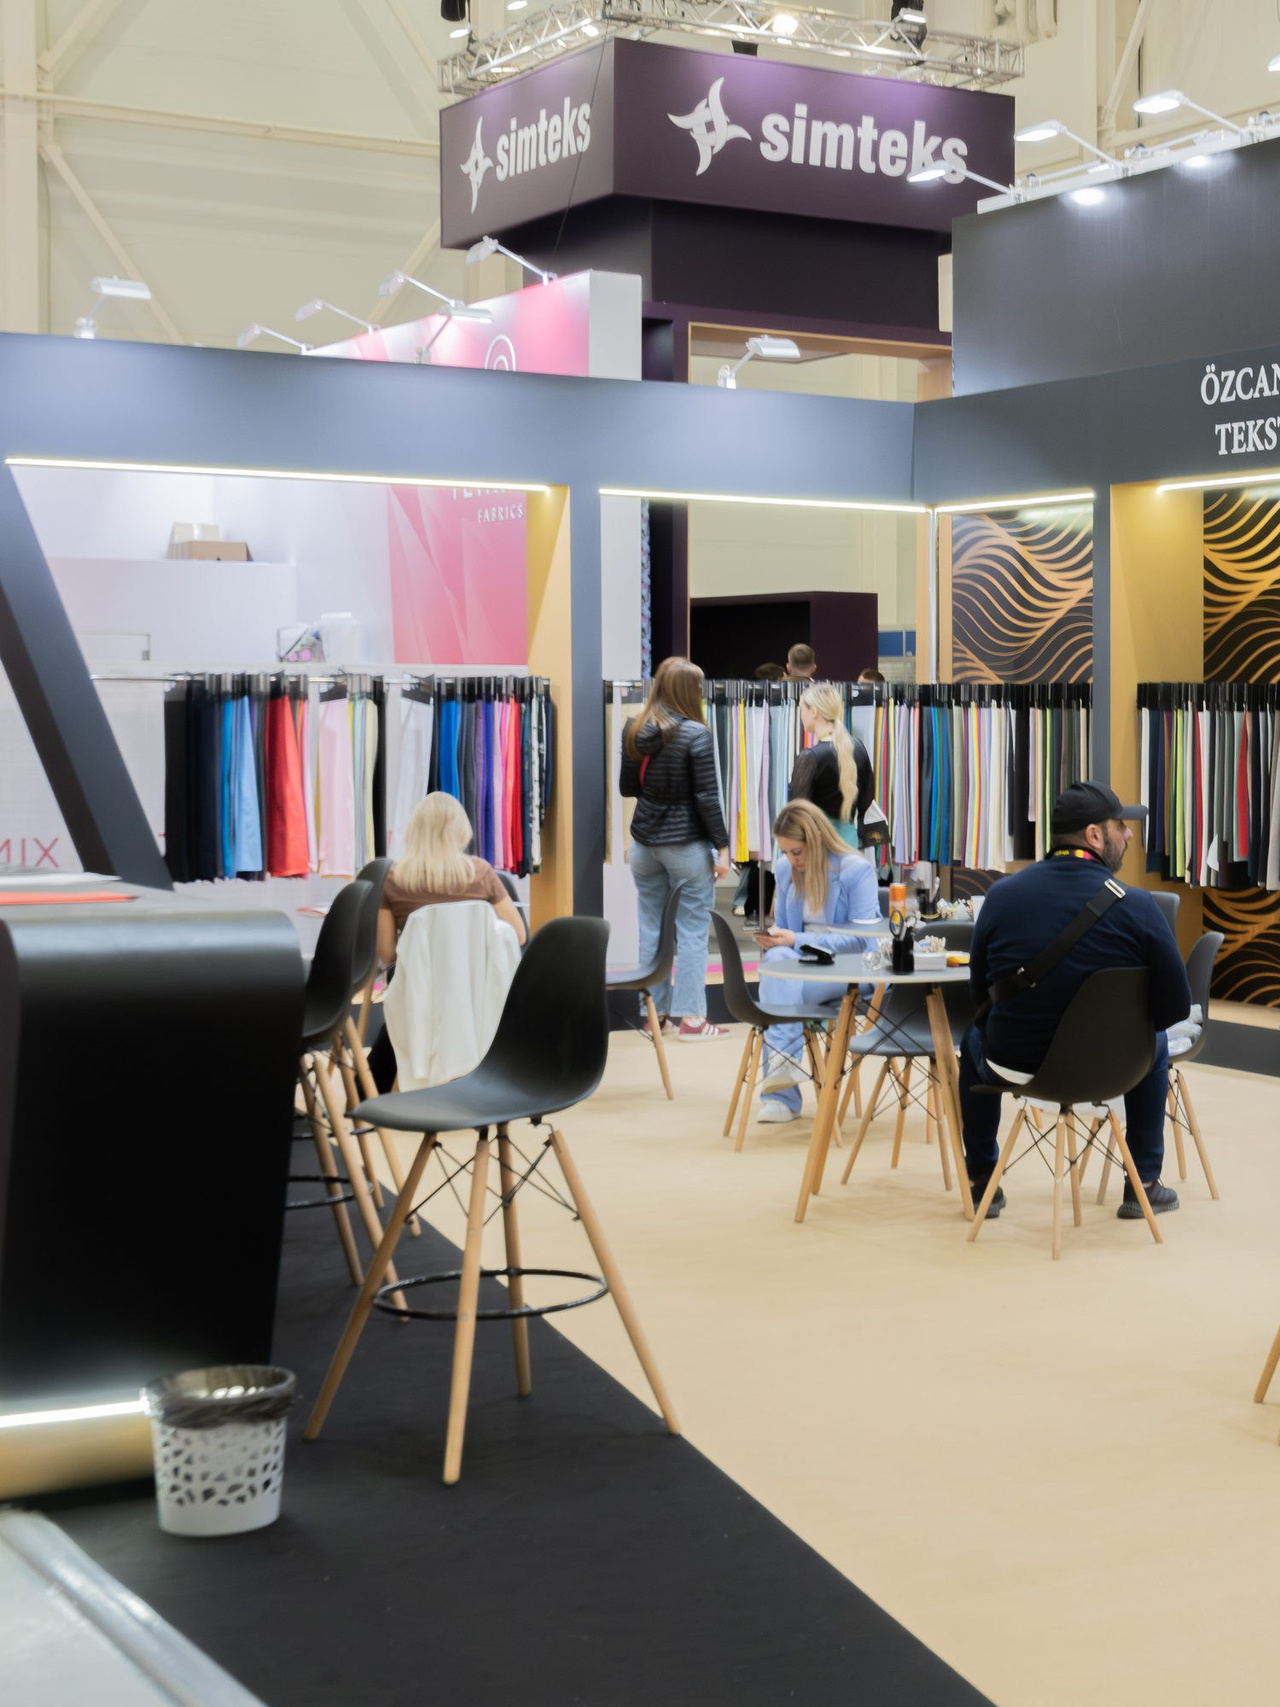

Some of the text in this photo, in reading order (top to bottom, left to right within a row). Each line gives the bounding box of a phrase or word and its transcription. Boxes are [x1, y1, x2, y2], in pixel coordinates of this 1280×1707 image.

[496, 96, 591, 182] simteks
[759, 103, 968, 184] simteks
[477, 503, 523, 523] FABRICS
